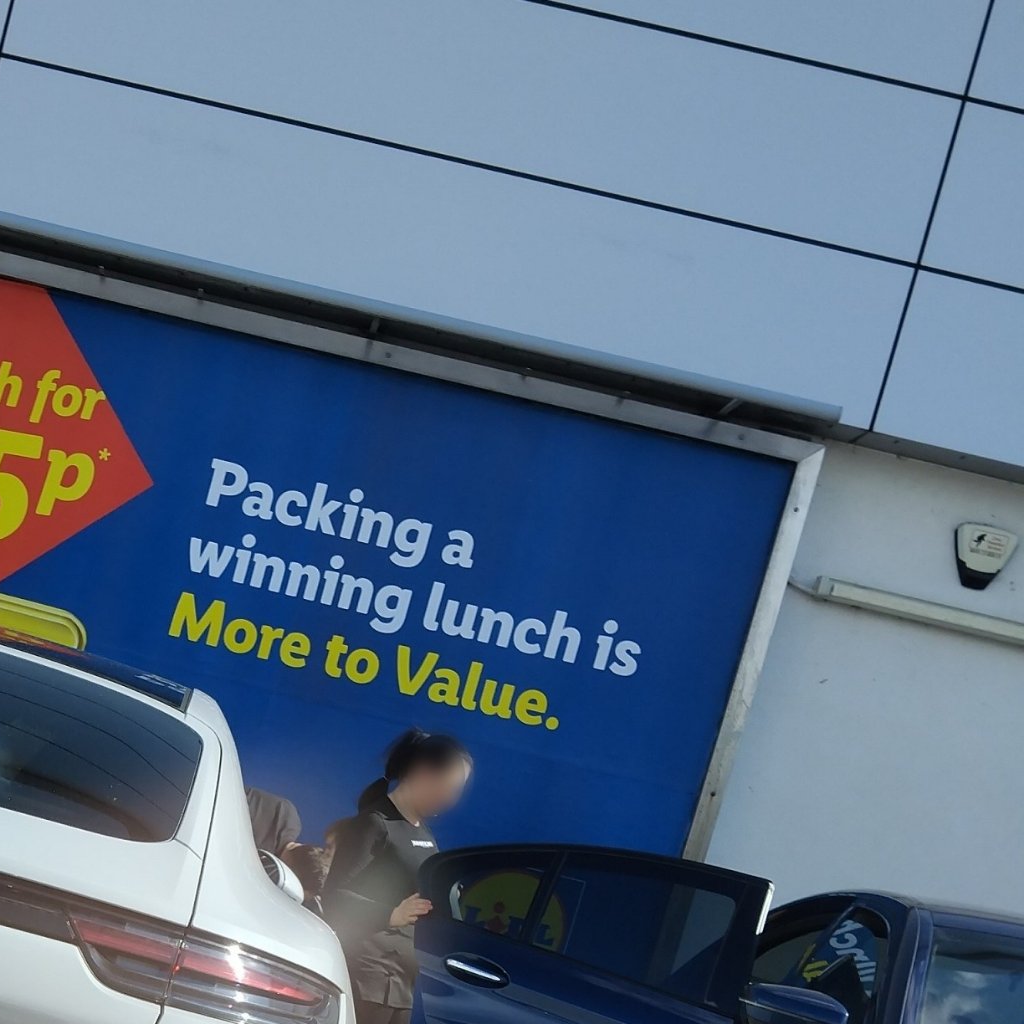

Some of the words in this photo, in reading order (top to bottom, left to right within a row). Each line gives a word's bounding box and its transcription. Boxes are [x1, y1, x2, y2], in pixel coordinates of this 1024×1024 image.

[28, 361, 107, 424] for
[205, 457, 434, 568] Packing
[441, 529, 474, 569] a
[168, 591, 312, 668] More
[324, 634, 380, 684] to
[396, 644, 560, 730] Value.
[189, 533, 413, 634] winning
[423, 581, 581, 665] lunch
[593, 619, 642, 677] is
